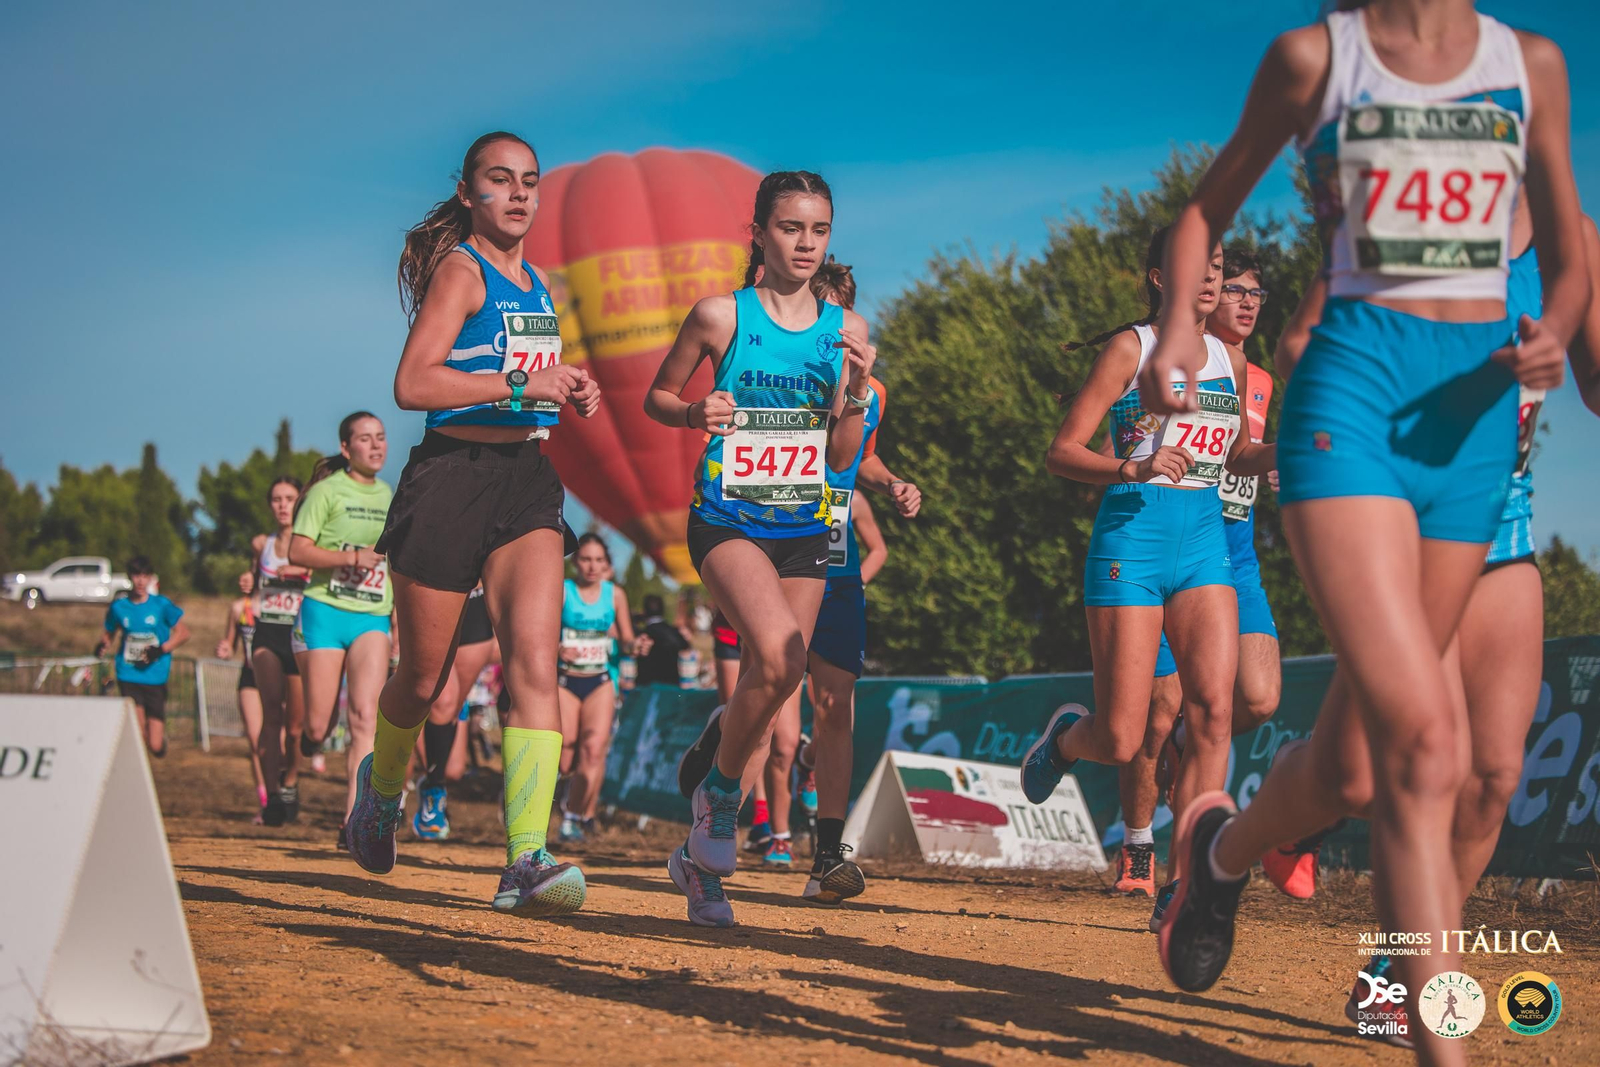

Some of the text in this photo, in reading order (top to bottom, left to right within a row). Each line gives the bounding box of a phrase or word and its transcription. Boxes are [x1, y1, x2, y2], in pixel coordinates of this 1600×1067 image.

[1357, 168, 1508, 225] 7487
[495, 299, 521, 310] vive
[528, 316, 556, 329] ITÁLICA
[1197, 393, 1233, 408] ITÁLICA
[755, 411, 804, 424] ITÁLICA
[734, 446, 818, 477] 5472
[337, 564, 386, 589] 5522
